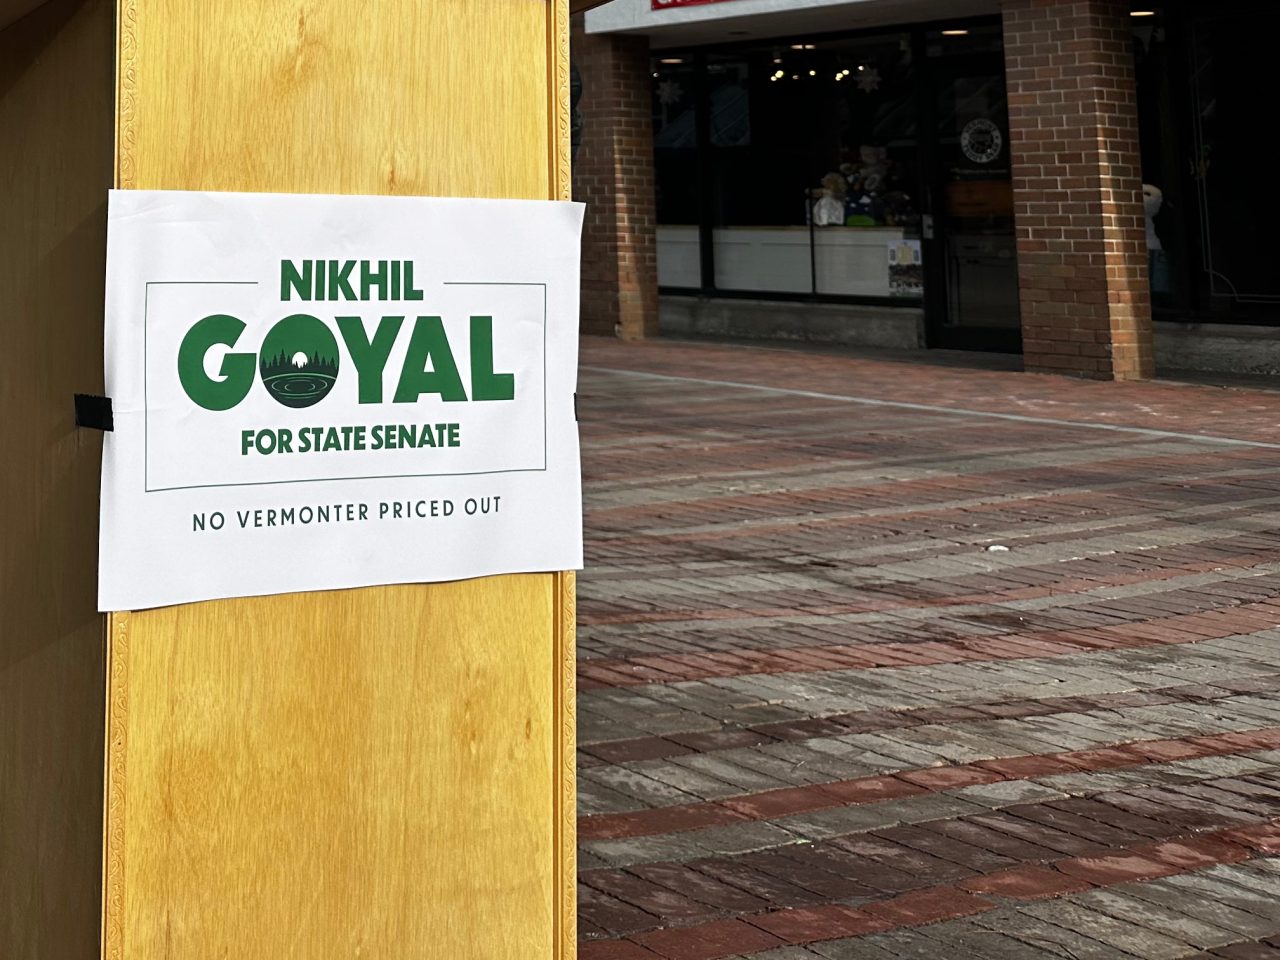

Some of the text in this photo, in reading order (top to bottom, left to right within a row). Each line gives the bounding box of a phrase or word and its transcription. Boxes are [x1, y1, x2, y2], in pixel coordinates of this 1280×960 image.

[280, 259, 424, 302] NIKHIL
[177, 313, 515, 412] GOYAL
[241, 423, 461, 456] FOR STATE SENATE
[193, 496, 501, 532] NO VERMONTER PRICED OUT
